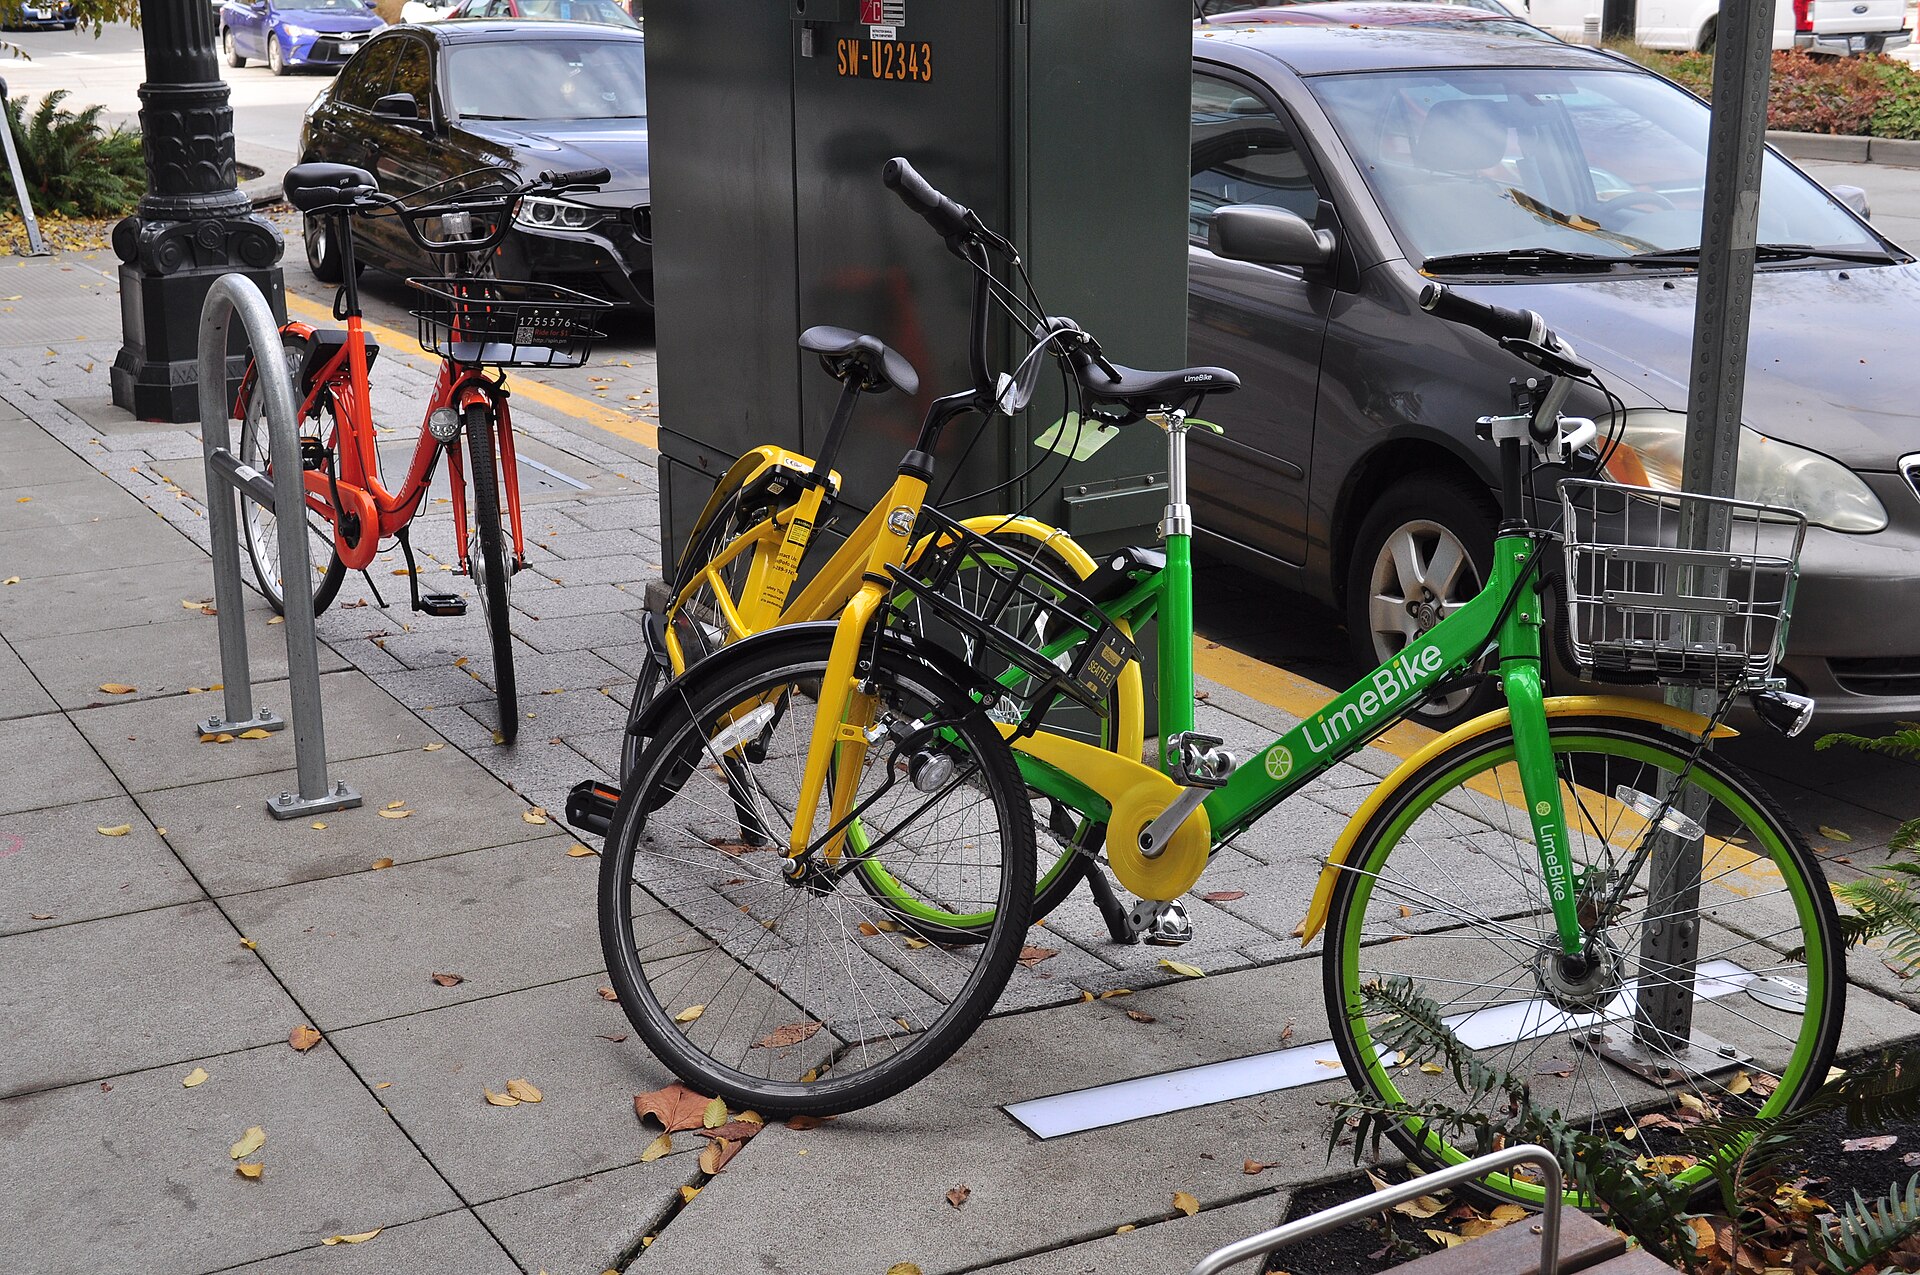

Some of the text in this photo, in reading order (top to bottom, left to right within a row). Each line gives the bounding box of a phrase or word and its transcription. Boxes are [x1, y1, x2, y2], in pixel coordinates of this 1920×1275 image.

[837, 39, 932, 81] SW-U2343
[519, 317, 571, 327] 1755576
[1184, 374, 1213, 383] LimeBike
[1087, 659, 1112, 684] SEATTLE
[1301, 645, 1444, 753] LimeBike
[1539, 824, 1566, 901] LimeBike
